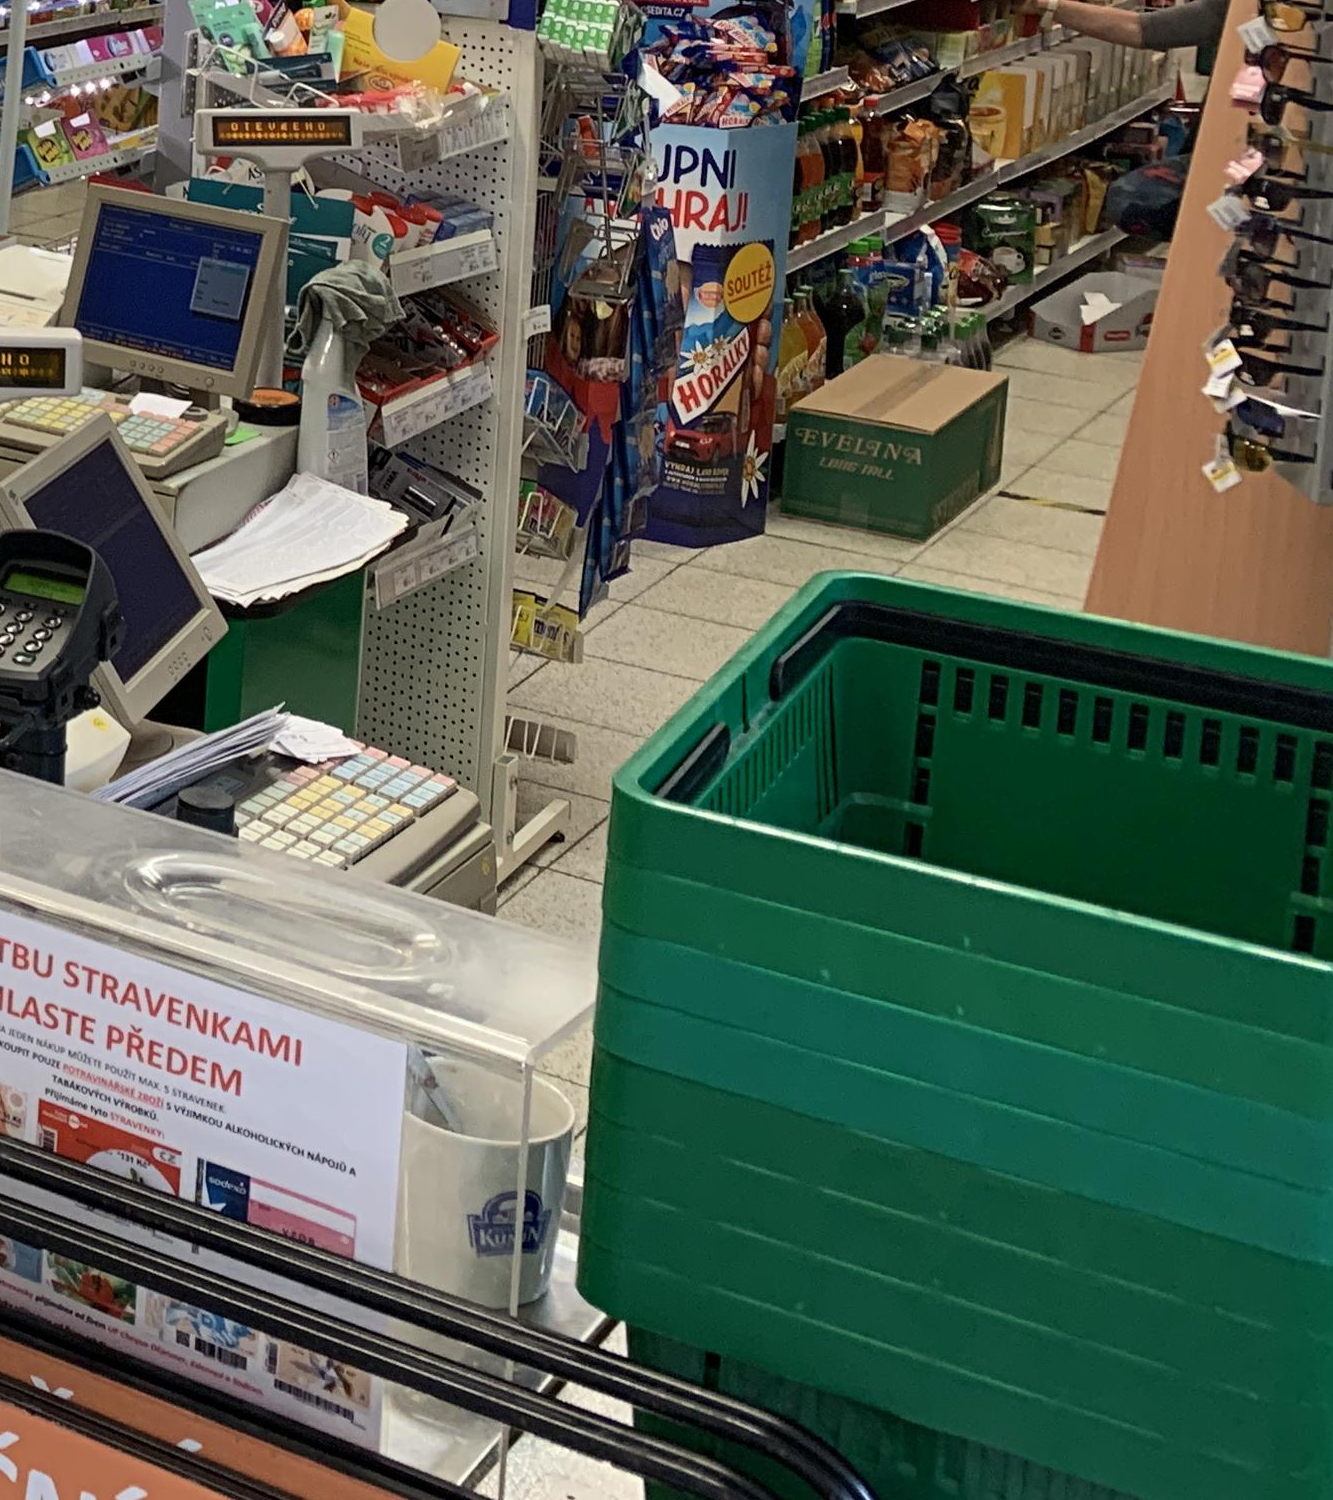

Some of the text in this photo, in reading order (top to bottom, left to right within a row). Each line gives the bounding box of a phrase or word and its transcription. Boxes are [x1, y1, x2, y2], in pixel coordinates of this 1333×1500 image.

[726, 260, 773, 298] SOUTĚŽ
[676, 334, 750, 414] HORALKY
[794, 426, 922, 466] EVELINA
[63, 961, 303, 1068] STRAVENKAMI
[8, 1026, 34, 1044] JEDEN
[35, 1035, 66, 1055] NÁKUP
[68, 1046, 102, 1070] MŮŽETE
[104, 1062, 137, 1085] POUŽÍT
[138, 1075, 162, 1092] MAX.
[172, 1087, 227, 1114] STRAVENEK.
[106, 1023, 243, 1098] PŘEDEM
[32, 1051, 62, 1070] POUZE
[62, 1063, 136, 1098] POTRAVINÁŘSKÉ
[174, 1103, 224, 1129] VÝJIMKOU
[224, 1123, 305, 1158] ALKOHOLICKÝCH
[306, 1150, 347, 1173] NÁPOJŮ
[44, 1087, 166, 1140] Přijímáme tyto STRAVENKY:
[51, 1075, 159, 1122] TABÁKOVÝCH VÝROBKŮ.
